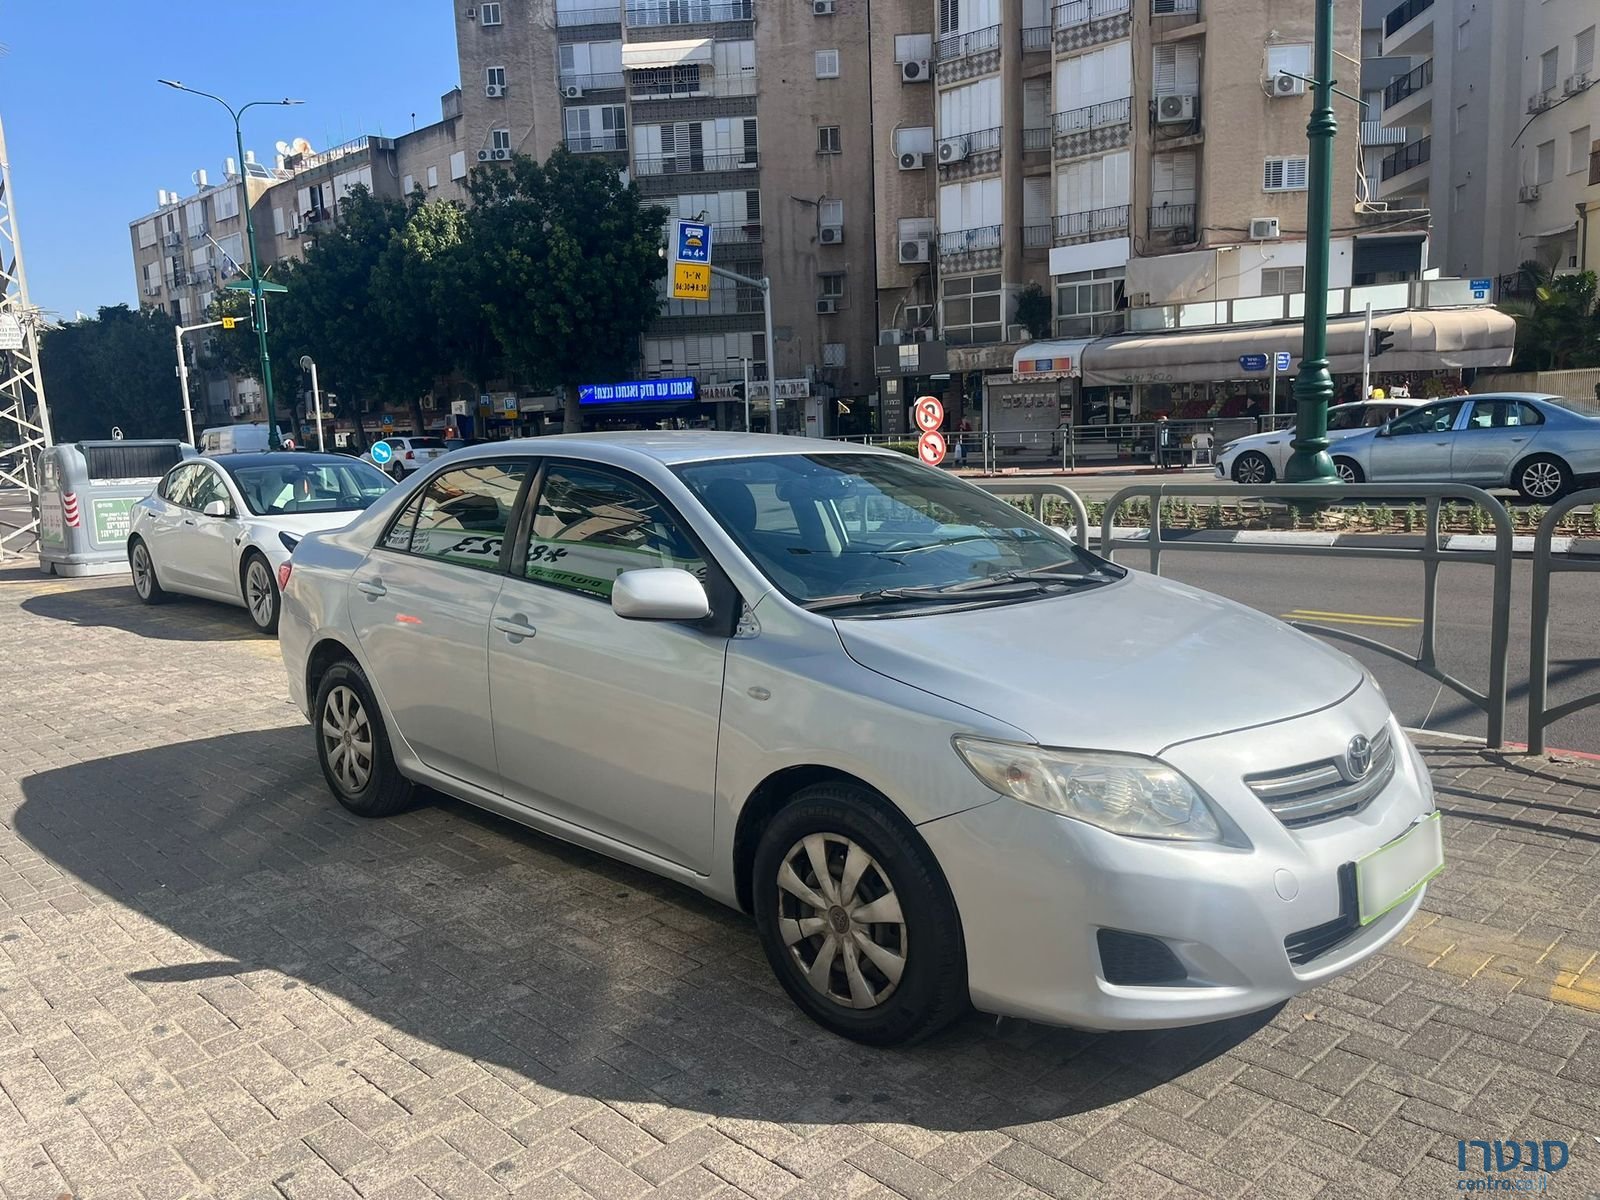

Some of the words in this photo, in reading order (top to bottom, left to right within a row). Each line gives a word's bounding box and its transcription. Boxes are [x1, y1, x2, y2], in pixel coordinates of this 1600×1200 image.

[694, 248, 705, 258] 4+
[225, 319, 233, 327] 13
[594, 385, 614, 400] ננצח!
[615, 384, 638, 398] ואנחנו
[640, 384, 655, 399] חזק
[657, 382, 668, 396] עם
[670, 381, 693, 395] אנחנו
